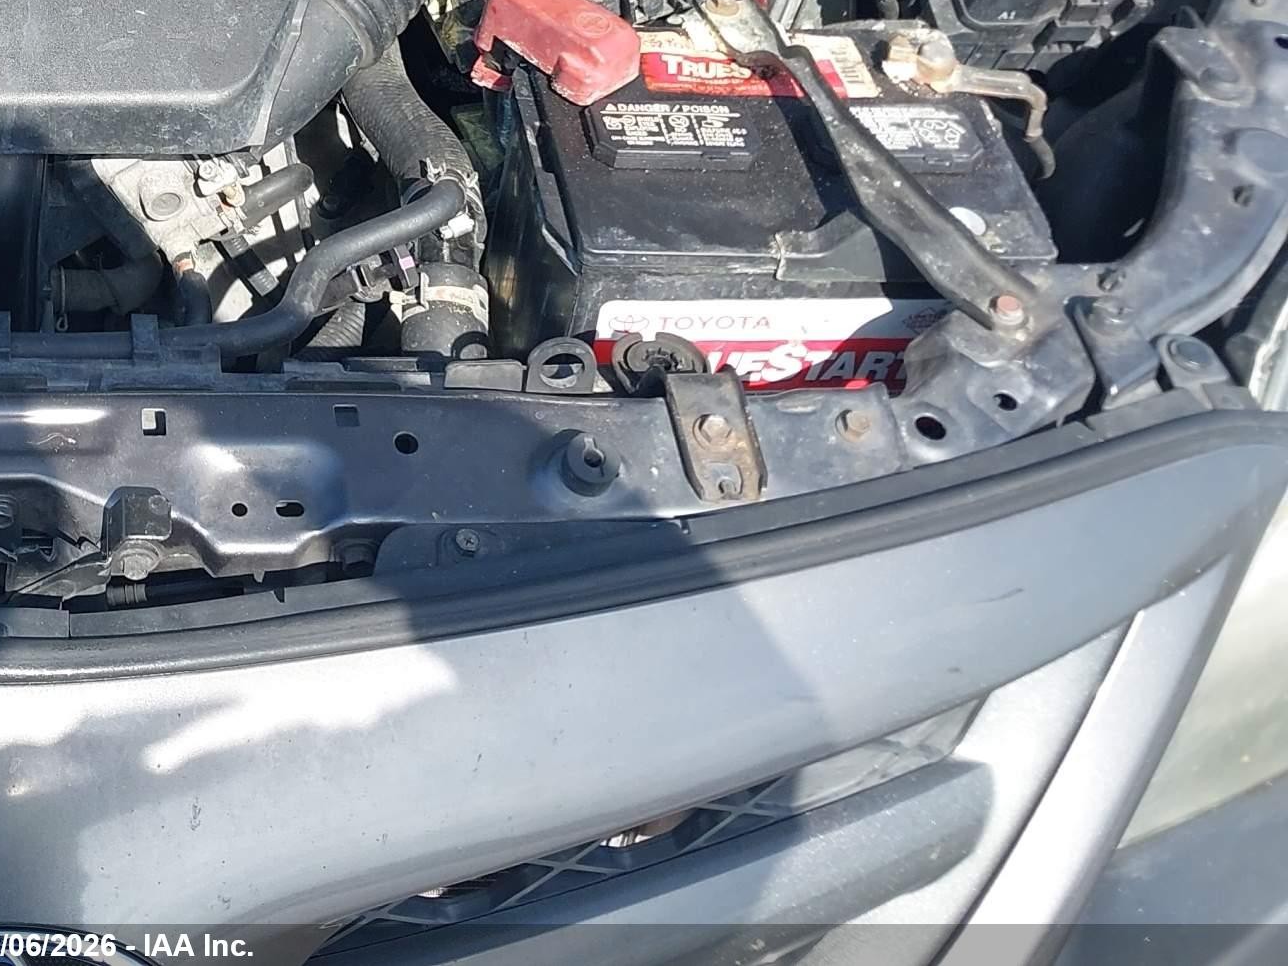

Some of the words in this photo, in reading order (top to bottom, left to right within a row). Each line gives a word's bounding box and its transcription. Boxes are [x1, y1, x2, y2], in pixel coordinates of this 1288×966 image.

[660, 53, 753, 80] TRUES
[616, 103, 671, 113] DANGER
[682, 104, 730, 114] POISON
[658, 315, 771, 331] TOYOTA
